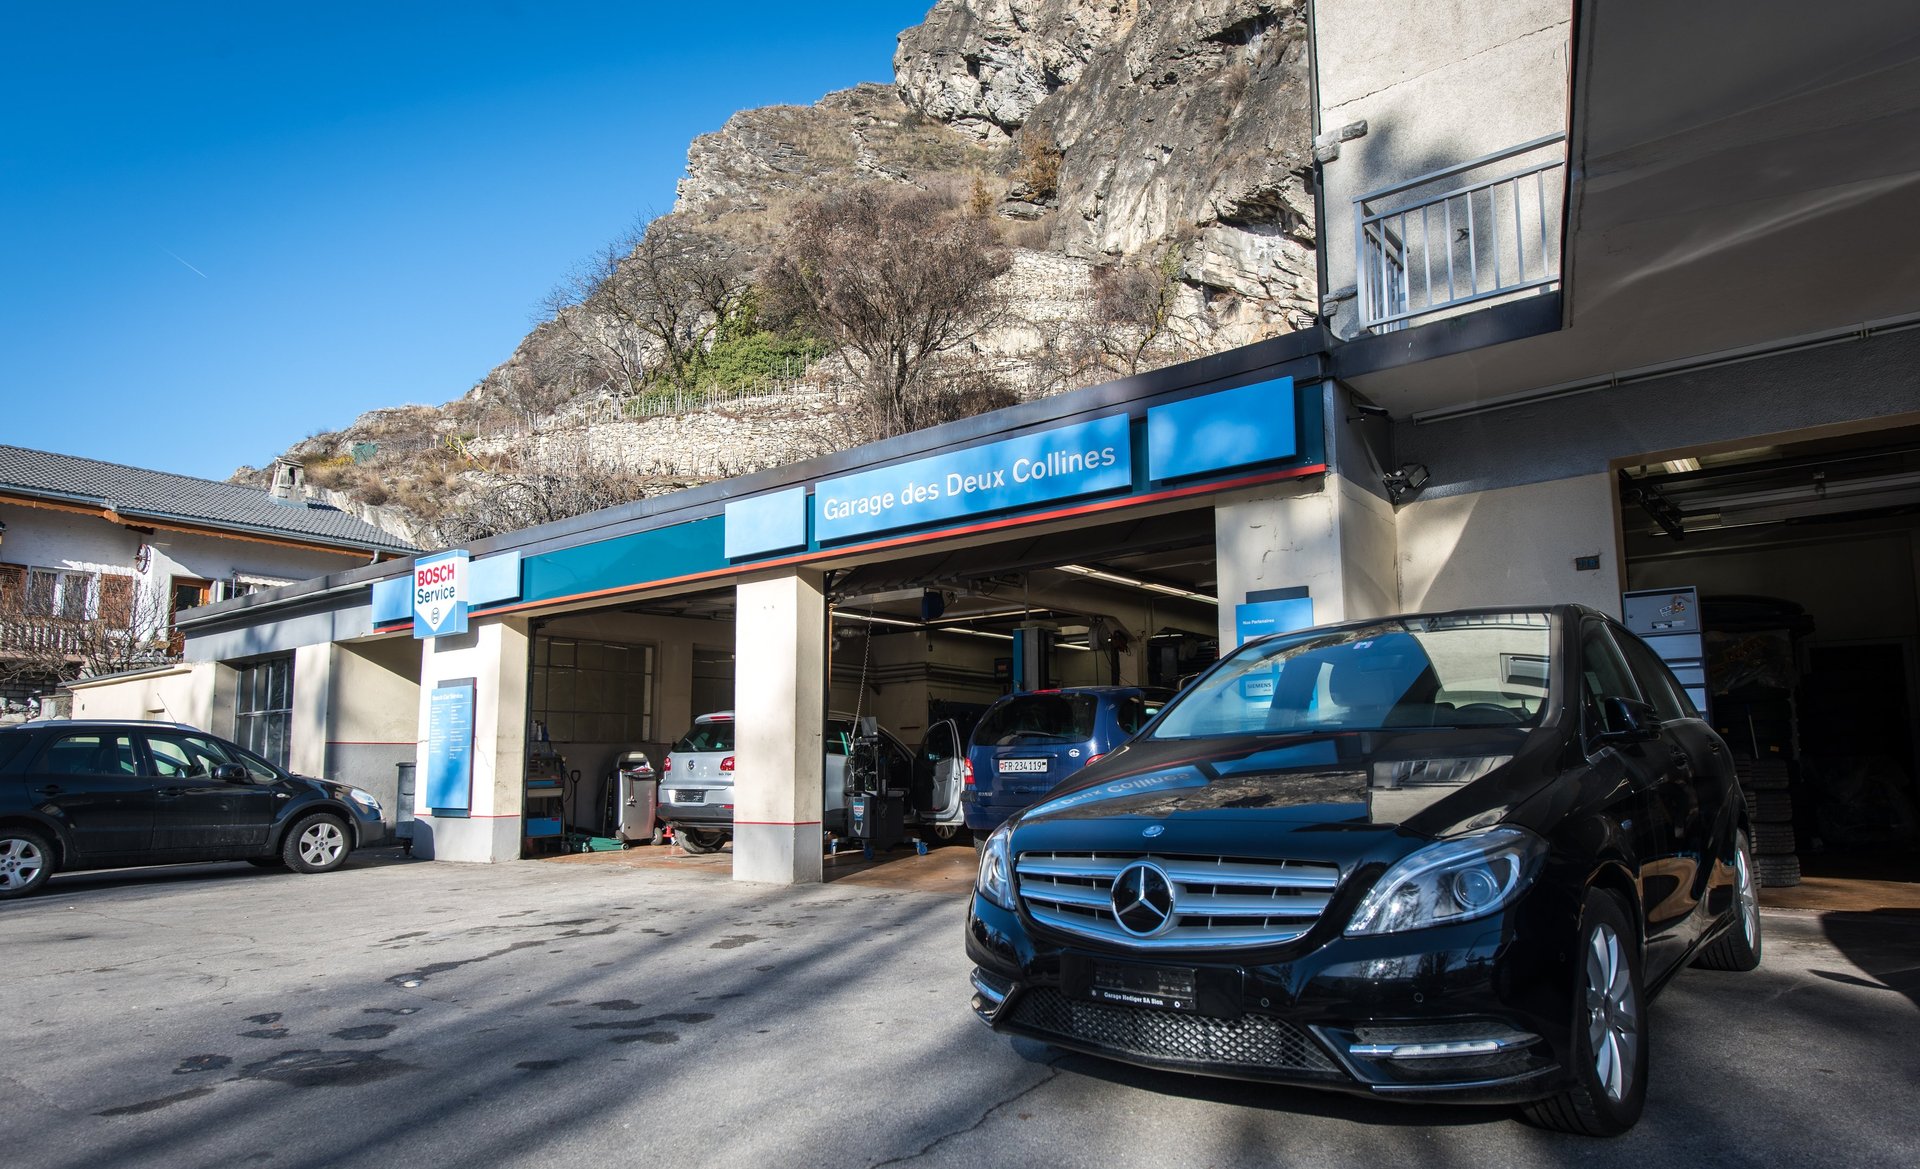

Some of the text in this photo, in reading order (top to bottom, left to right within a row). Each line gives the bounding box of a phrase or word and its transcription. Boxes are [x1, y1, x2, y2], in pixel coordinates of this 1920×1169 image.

[823, 447, 1116, 521] Garage des Deux Collines
[417, 563, 455, 587] BOSCH
[417, 584, 455, 605] Service
[1104, 991, 1122, 1001] Garage
